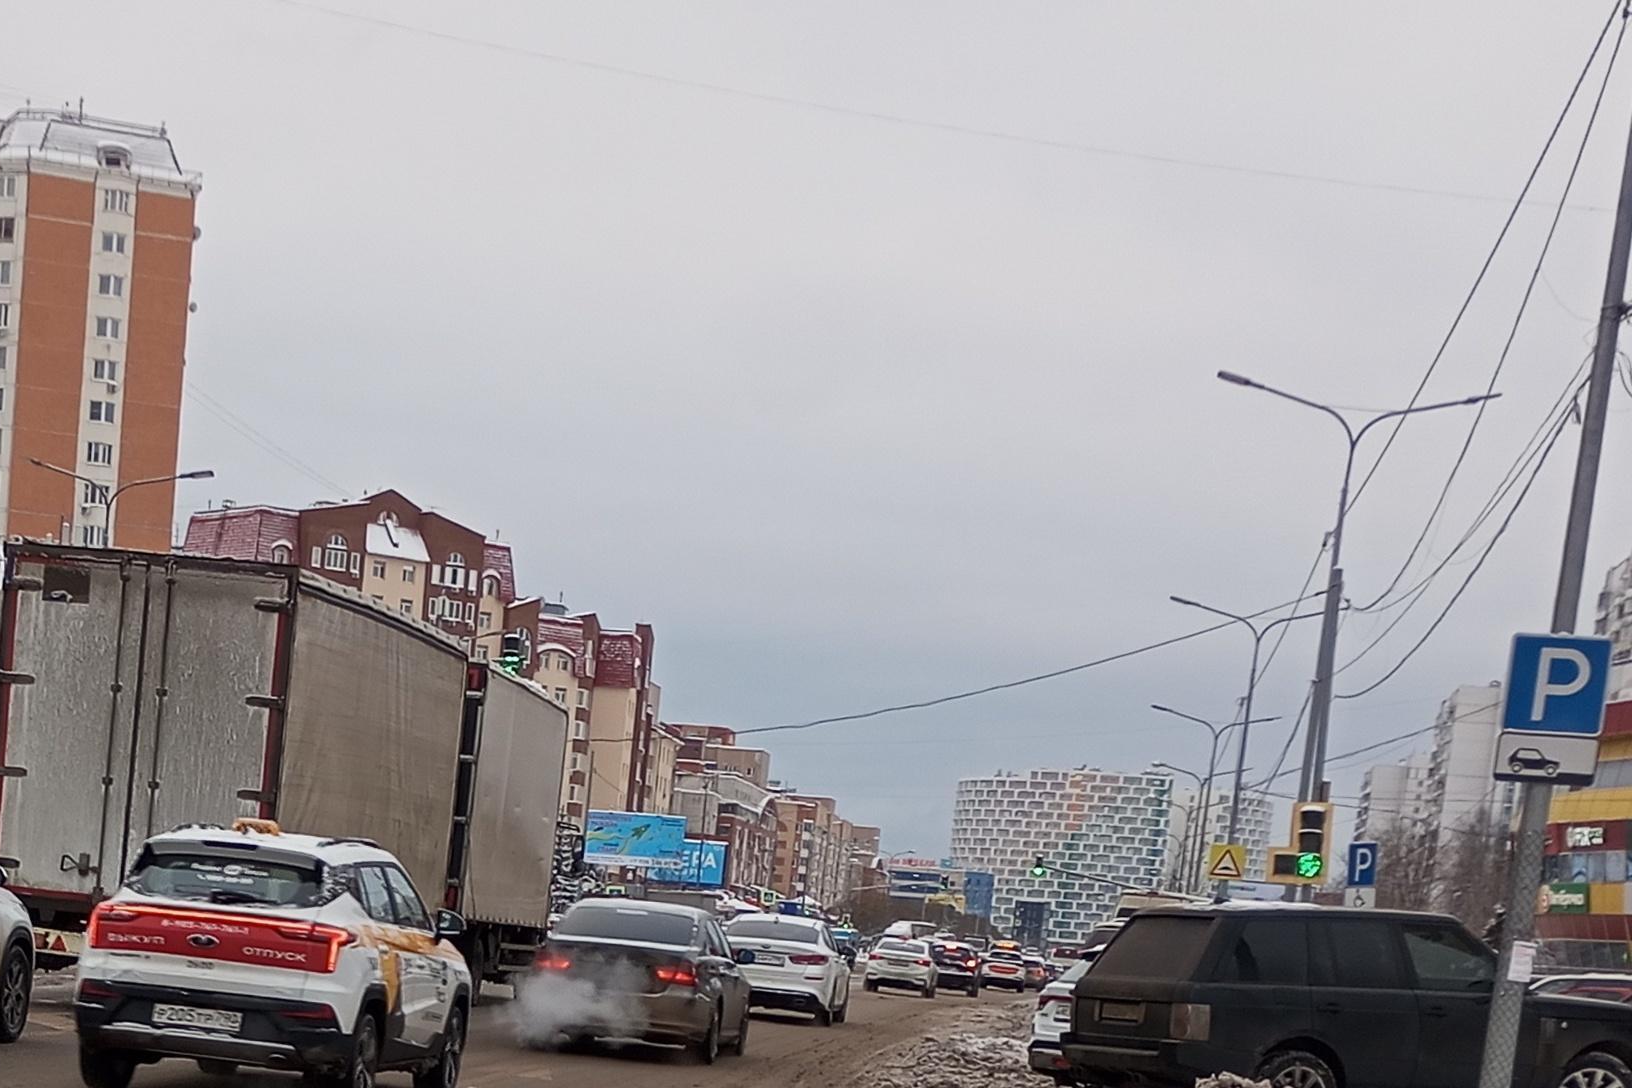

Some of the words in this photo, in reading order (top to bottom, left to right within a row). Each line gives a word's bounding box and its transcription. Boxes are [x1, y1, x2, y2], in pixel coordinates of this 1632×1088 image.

[1530, 647, 1591, 721] P
[1354, 848, 1372, 882] P
[242, 946, 307, 962] ОТПУСК
